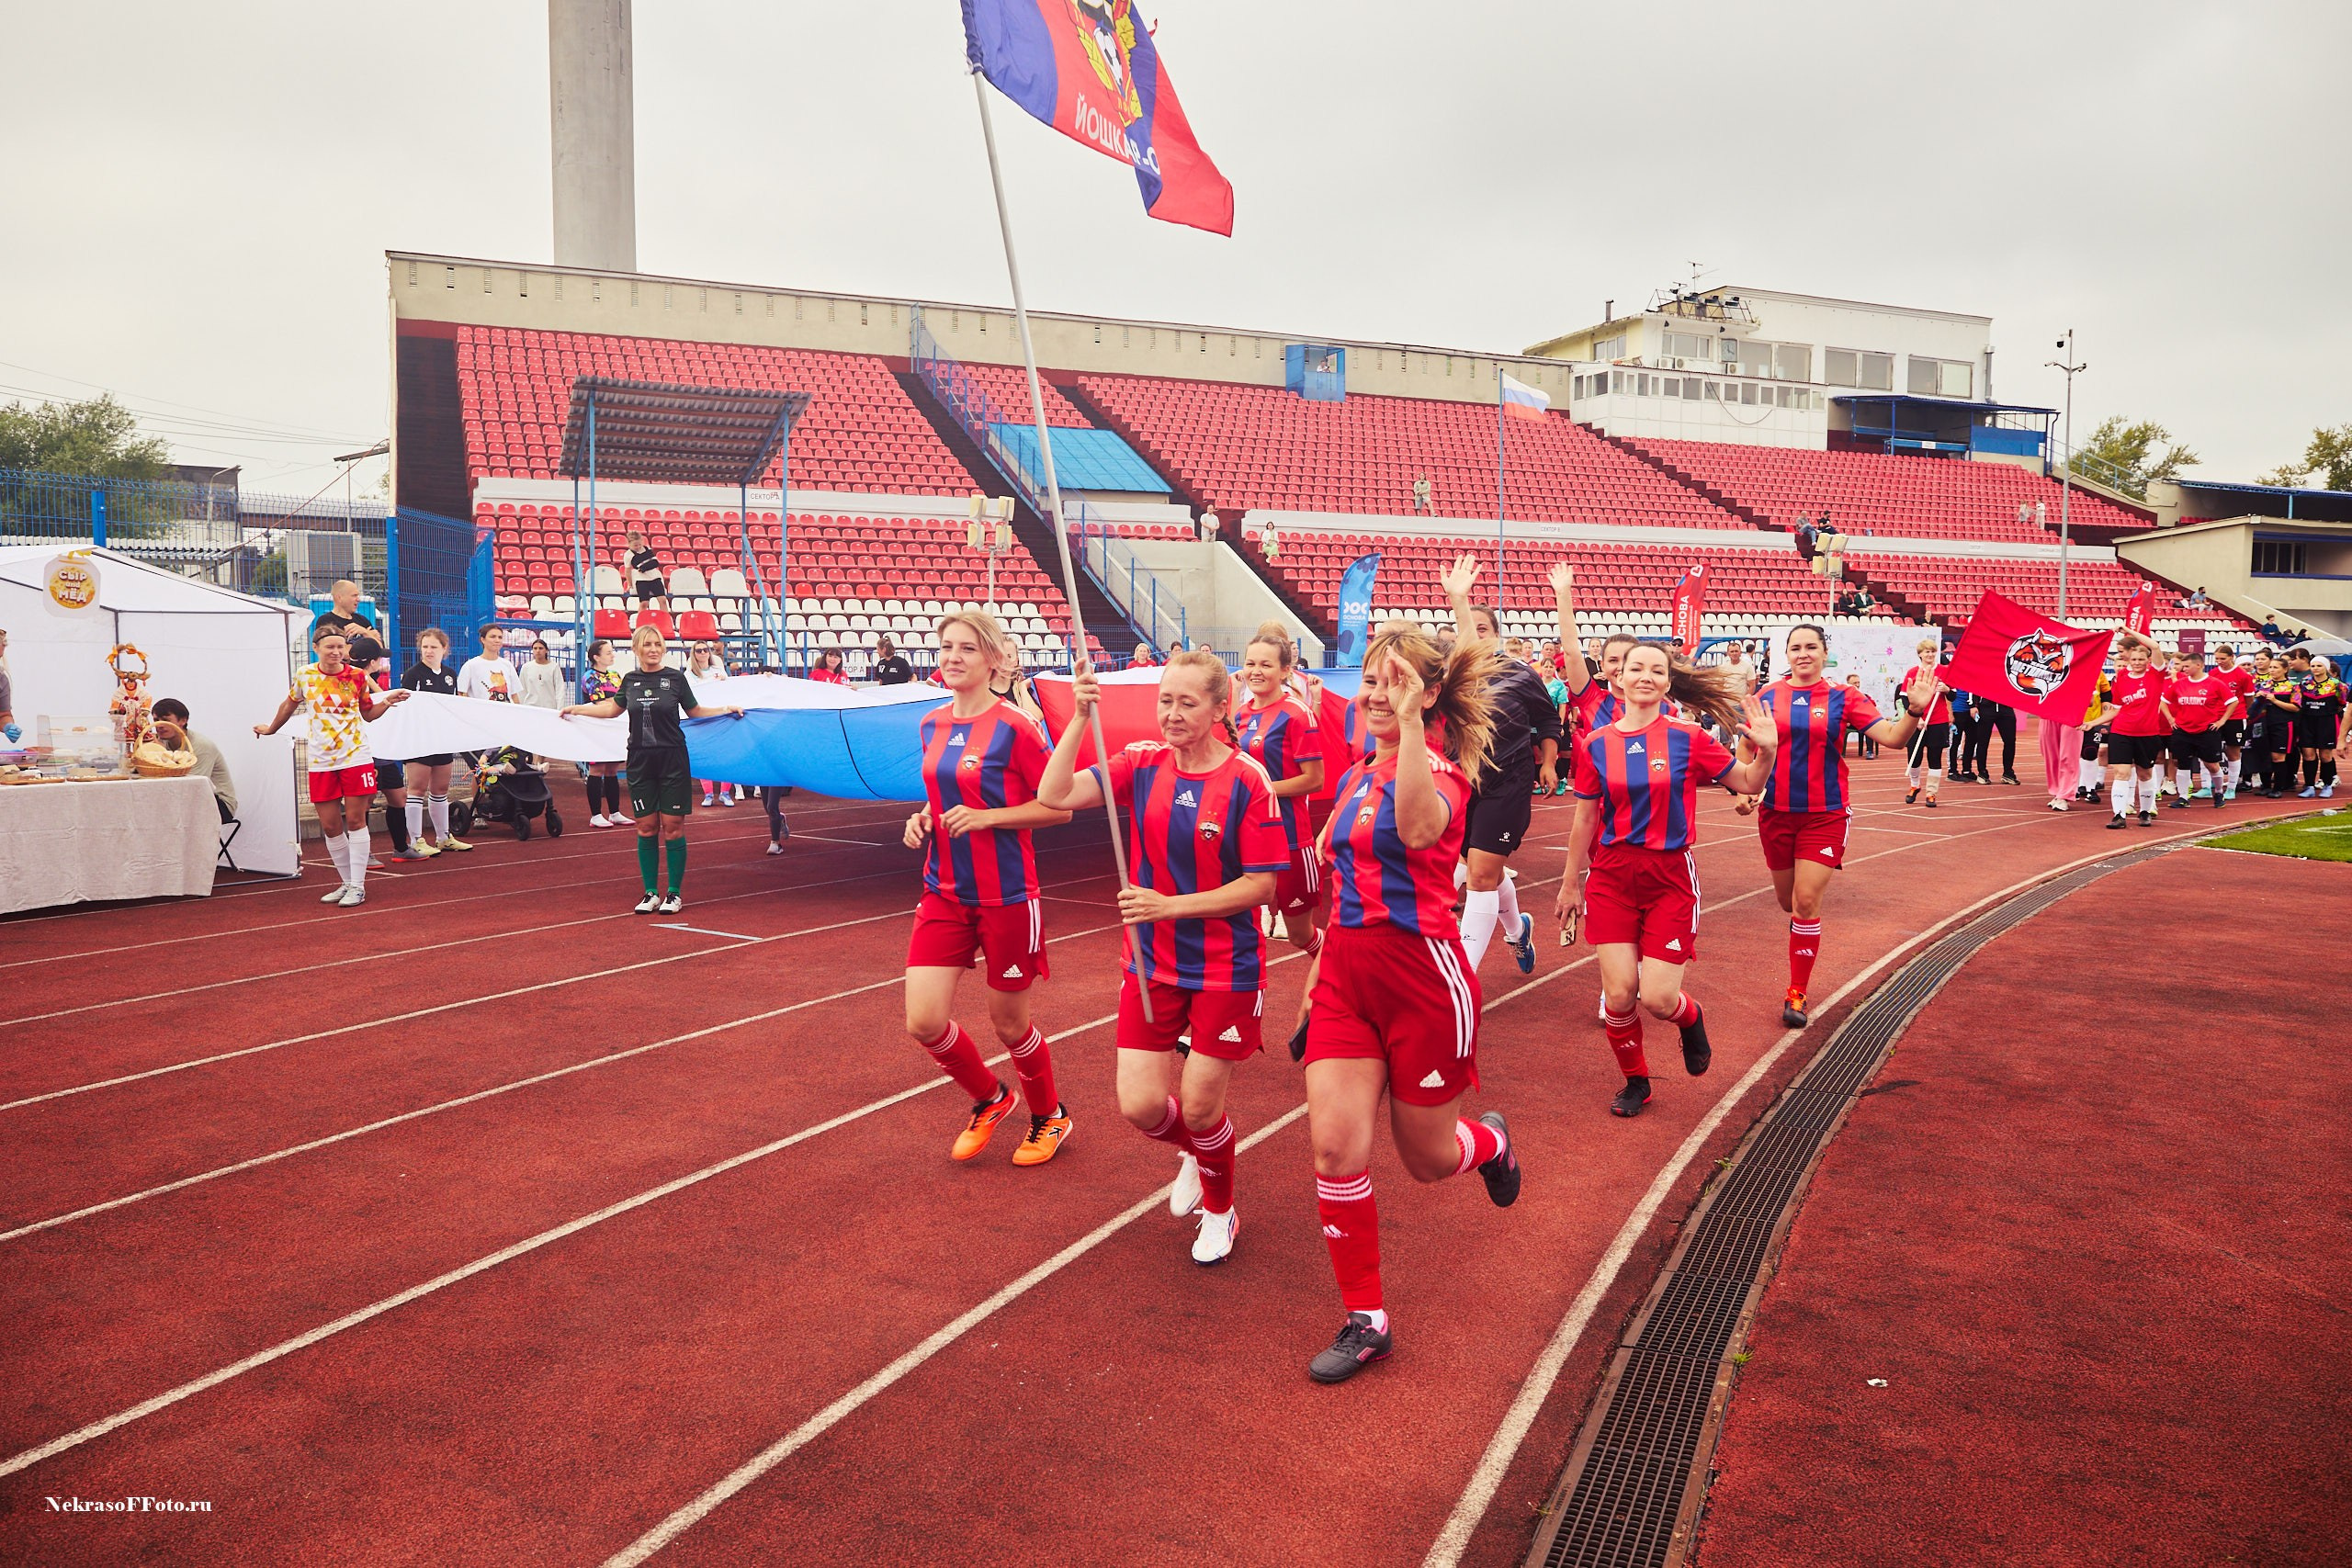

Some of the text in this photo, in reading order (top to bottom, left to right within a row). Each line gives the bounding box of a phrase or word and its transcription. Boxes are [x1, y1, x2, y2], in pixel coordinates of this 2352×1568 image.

[361, 773, 375, 787] 15
[633, 798, 645, 811] 11
[1174, 798, 1197, 808] adidas
